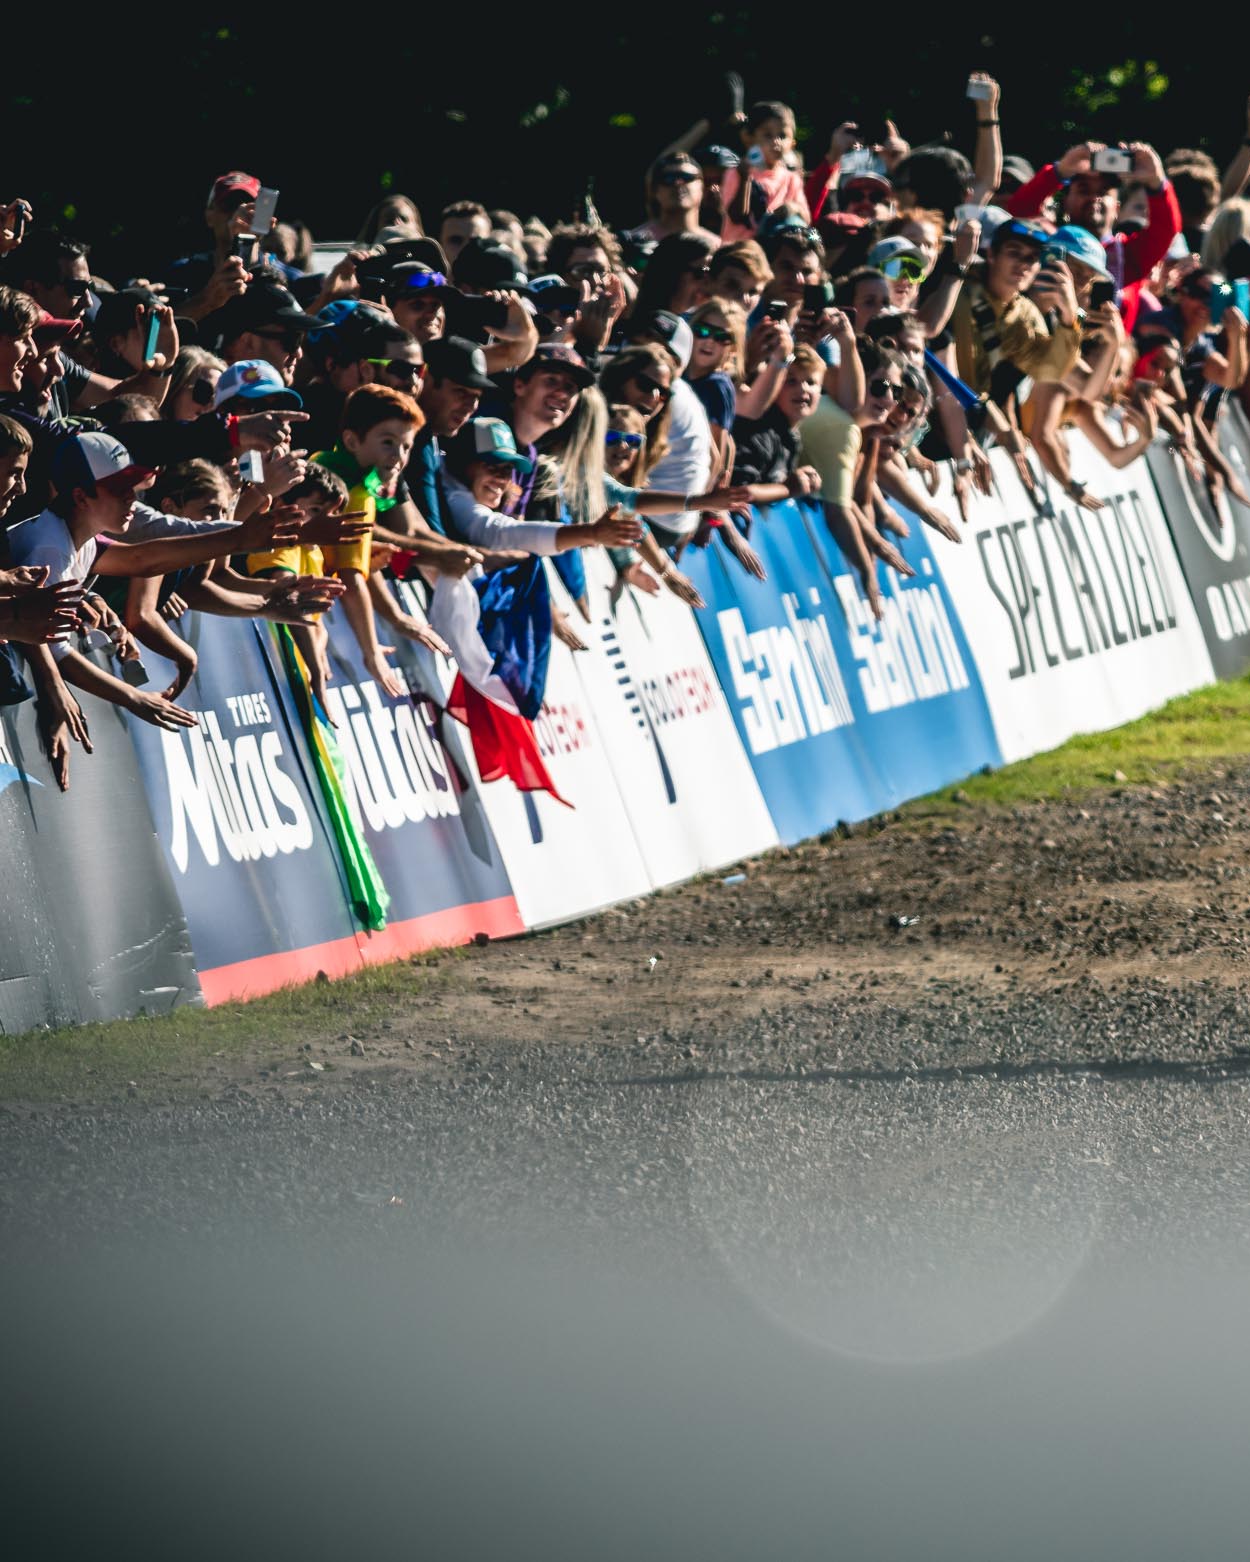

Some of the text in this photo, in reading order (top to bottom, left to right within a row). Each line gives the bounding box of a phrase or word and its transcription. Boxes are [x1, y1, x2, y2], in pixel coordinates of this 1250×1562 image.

[225, 691, 272, 727] TIRES
[717, 587, 855, 755] Santini
[160, 710, 314, 874] Mitas
